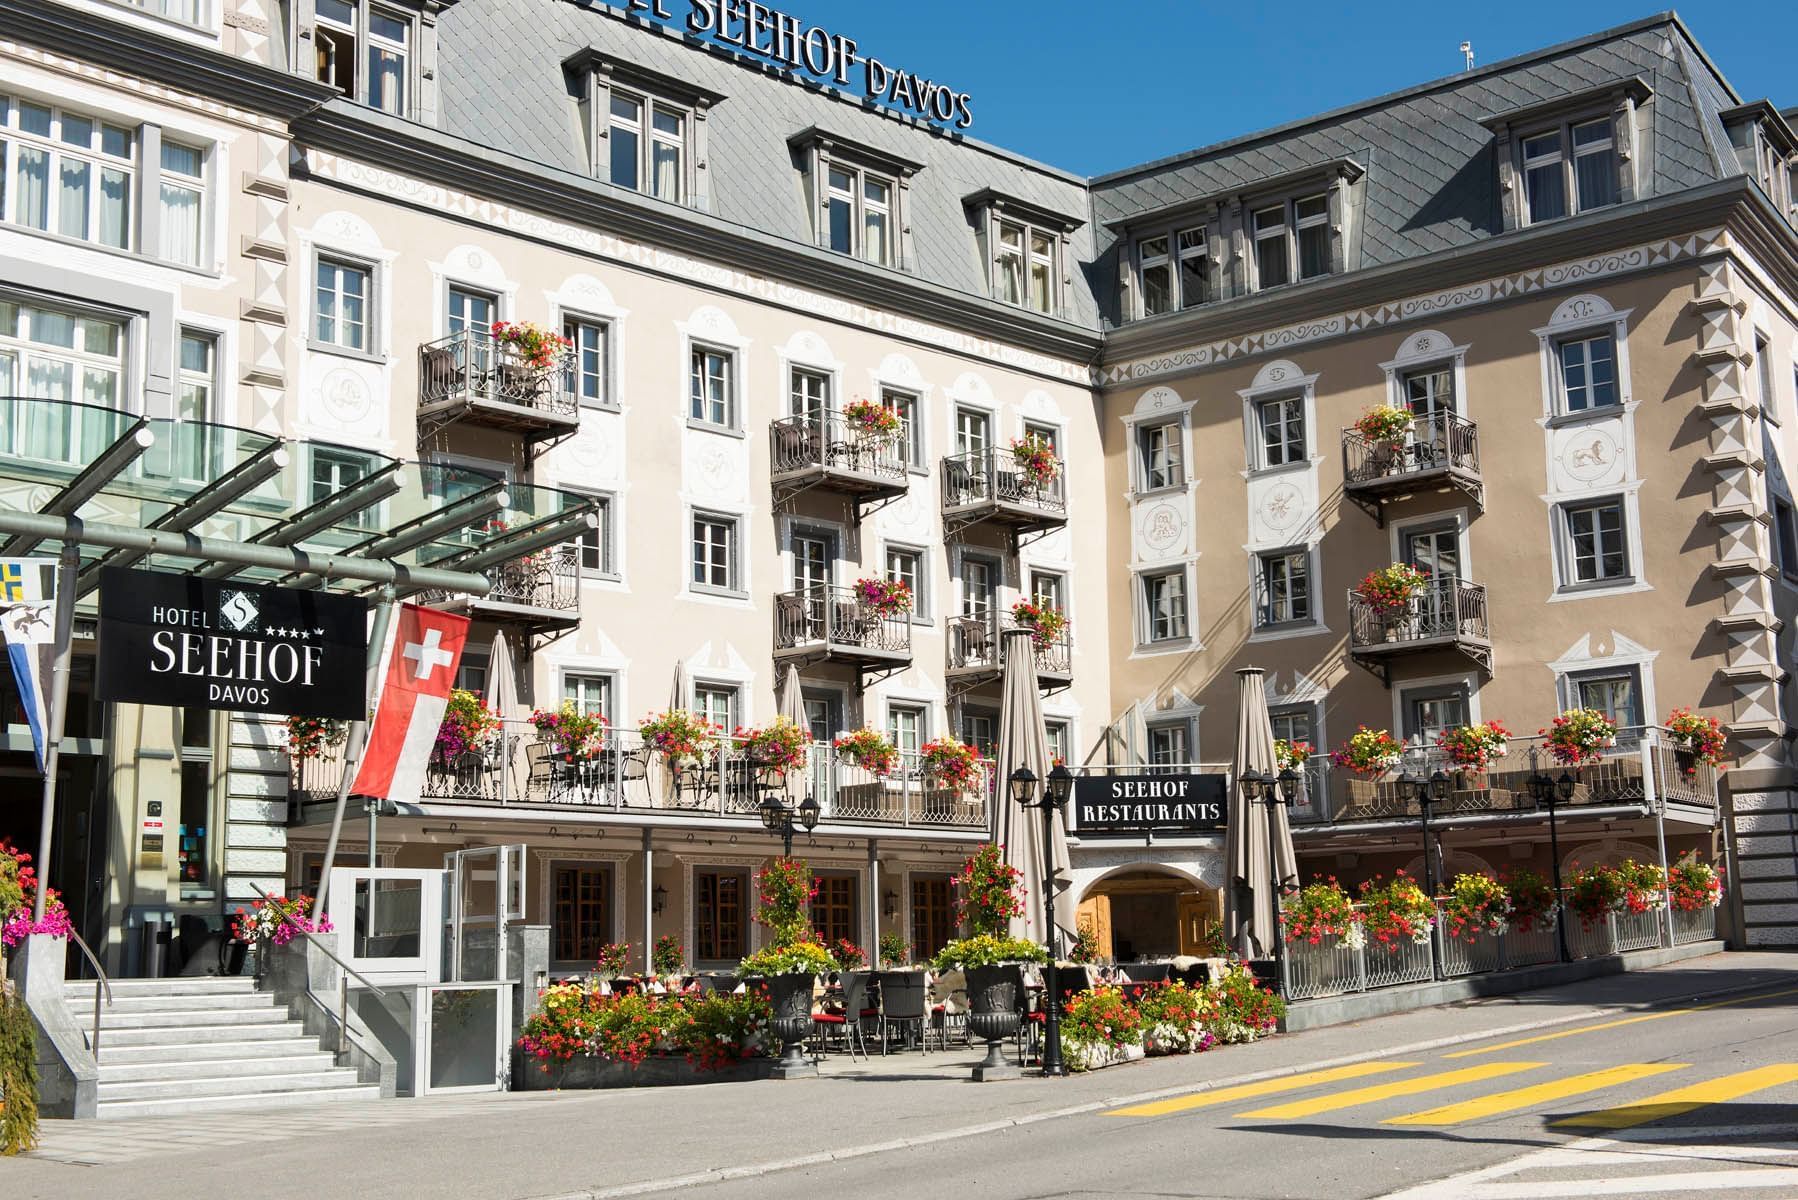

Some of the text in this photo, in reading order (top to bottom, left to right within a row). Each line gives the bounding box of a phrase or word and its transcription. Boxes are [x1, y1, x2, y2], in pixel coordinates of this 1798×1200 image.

[866, 57, 973, 128] DAVOS
[152, 605, 211, 629] HOTEL
[150, 630, 323, 686] SEEHOF
[209, 683, 269, 705] DAVOS
[1112, 780, 1189, 798] SEEHOF
[1083, 803, 1220, 822] RESTAURANTS
